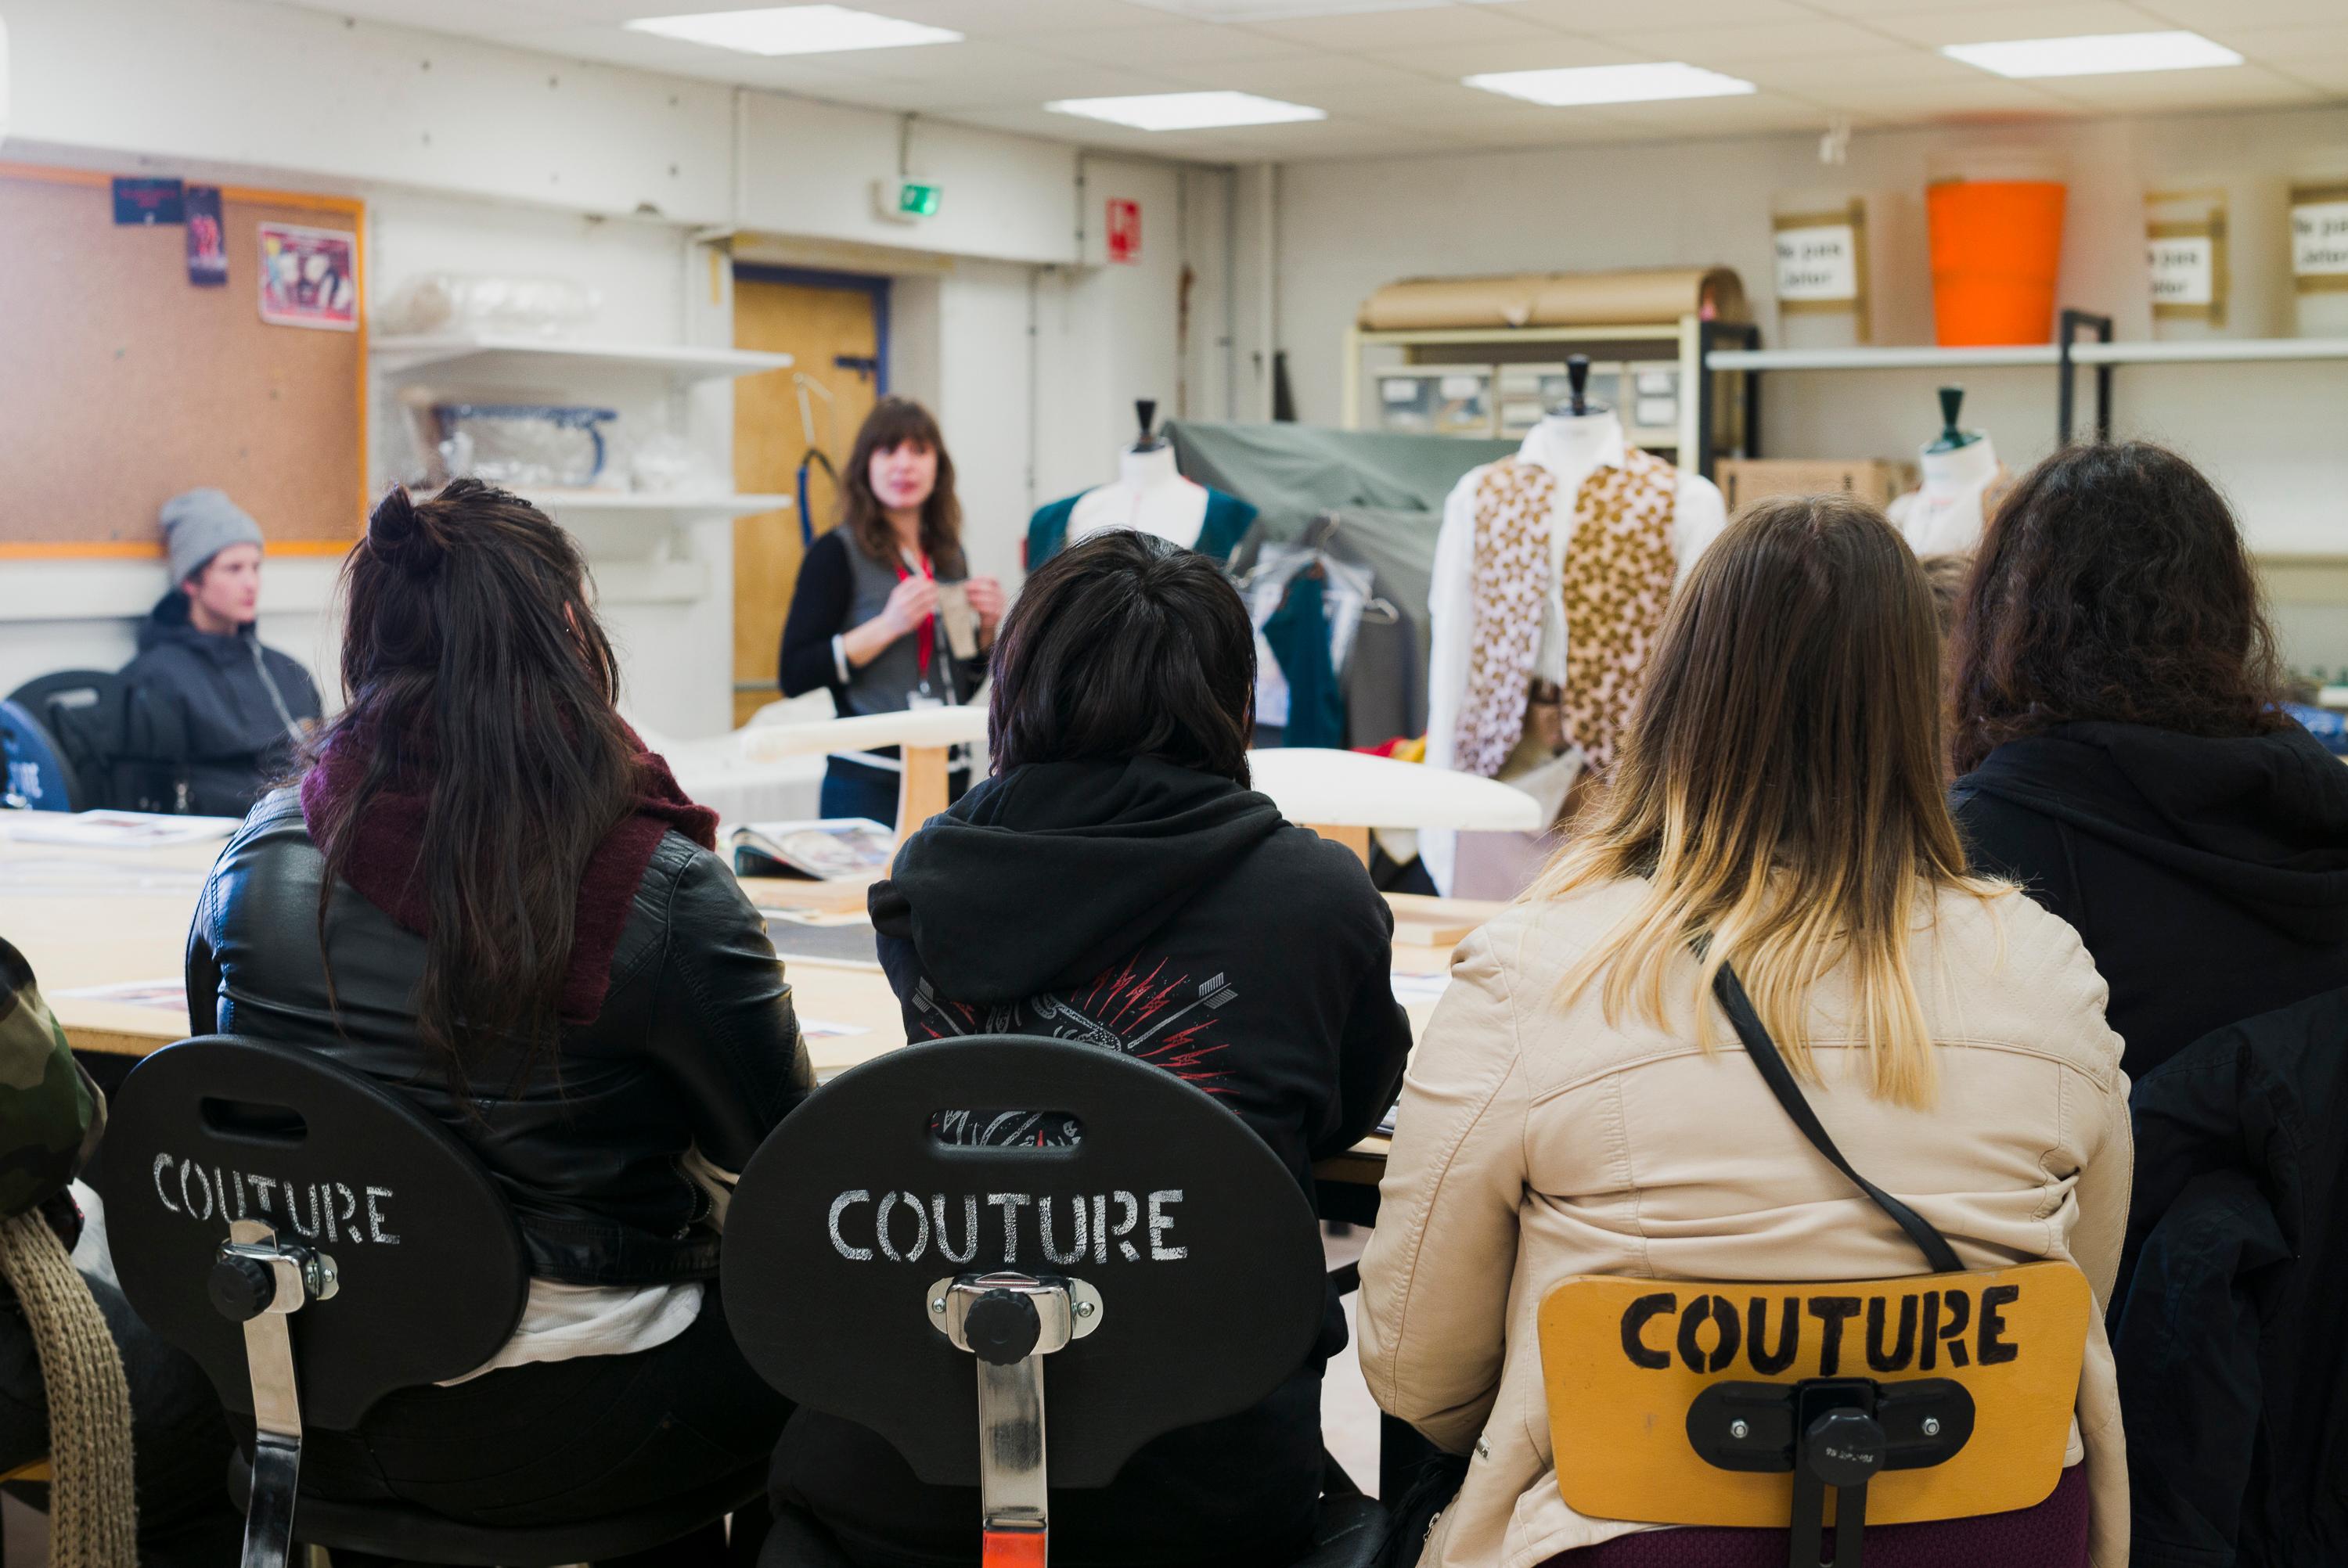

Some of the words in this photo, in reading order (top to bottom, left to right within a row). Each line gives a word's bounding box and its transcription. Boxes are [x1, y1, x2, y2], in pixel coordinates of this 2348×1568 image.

[153, 1153, 400, 1244] COUTURE
[828, 1189, 1188, 1264] COUTURE
[1620, 1284, 2019, 1377] COUTURE
